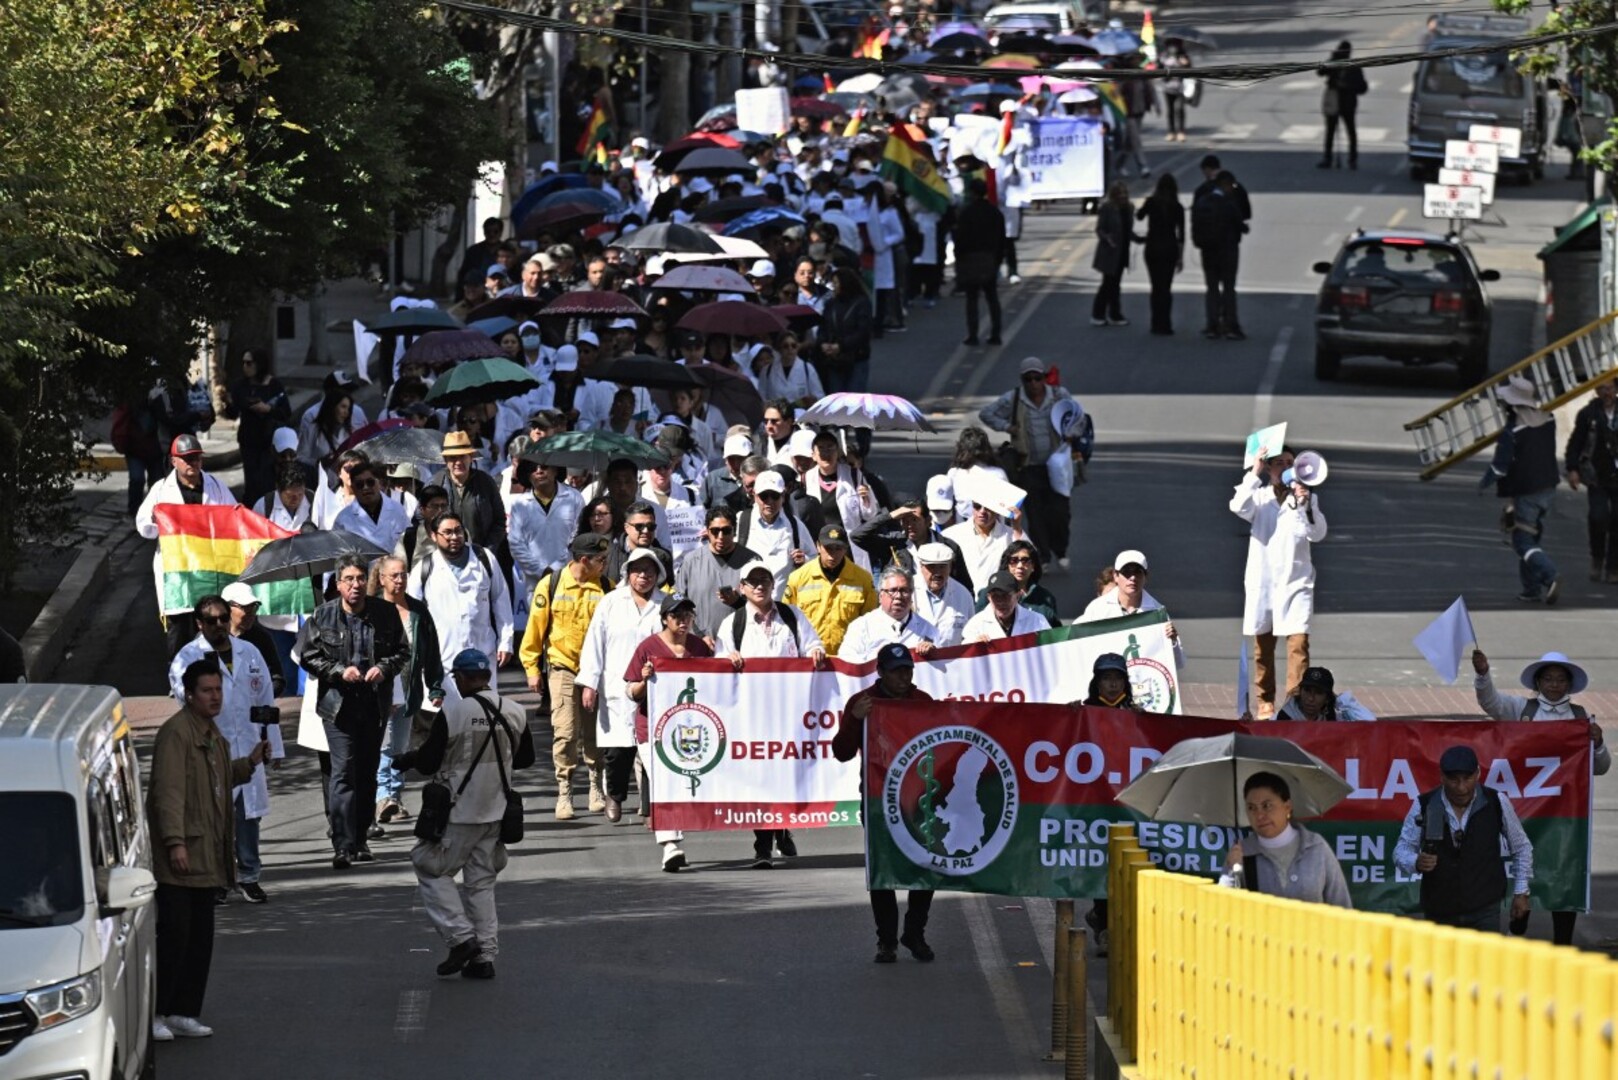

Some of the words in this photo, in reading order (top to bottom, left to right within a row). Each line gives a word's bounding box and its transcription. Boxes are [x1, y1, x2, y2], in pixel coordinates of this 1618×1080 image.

[731, 740, 837, 760] DEPART
[898, 729, 999, 766] DEPARTAMENTAL
[998, 759, 1013, 778] DE
[1345, 758, 1420, 799] LA
[1484, 757, 1562, 798] AZ
[886, 768, 901, 825] COMITÉ
[1001, 781, 1015, 830] SALUD
[789, 810, 849, 823] somos
[931, 856, 948, 868] LA
[952, 857, 974, 869] PAZ
[1336, 835, 1385, 860] EN
[1040, 848, 1109, 867] UNID
[1149, 852, 1201, 872] POR
[1352, 865, 1385, 883] DE
